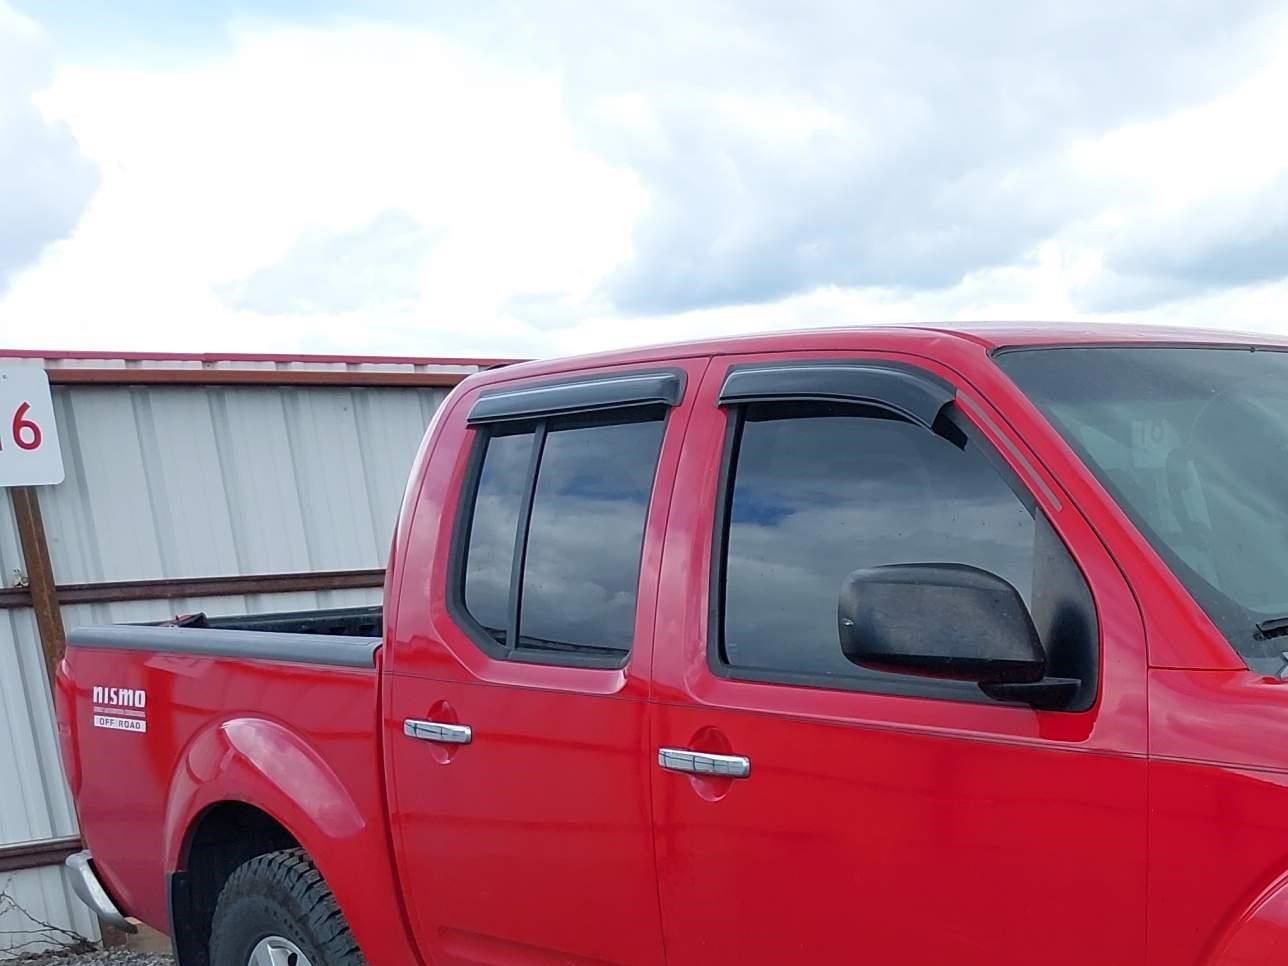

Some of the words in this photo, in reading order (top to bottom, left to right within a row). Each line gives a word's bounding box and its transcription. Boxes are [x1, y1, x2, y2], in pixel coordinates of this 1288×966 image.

[0, 401, 42, 451] 6
[99, 717, 115, 728] OFF
[118, 719, 142, 730] ROAD
